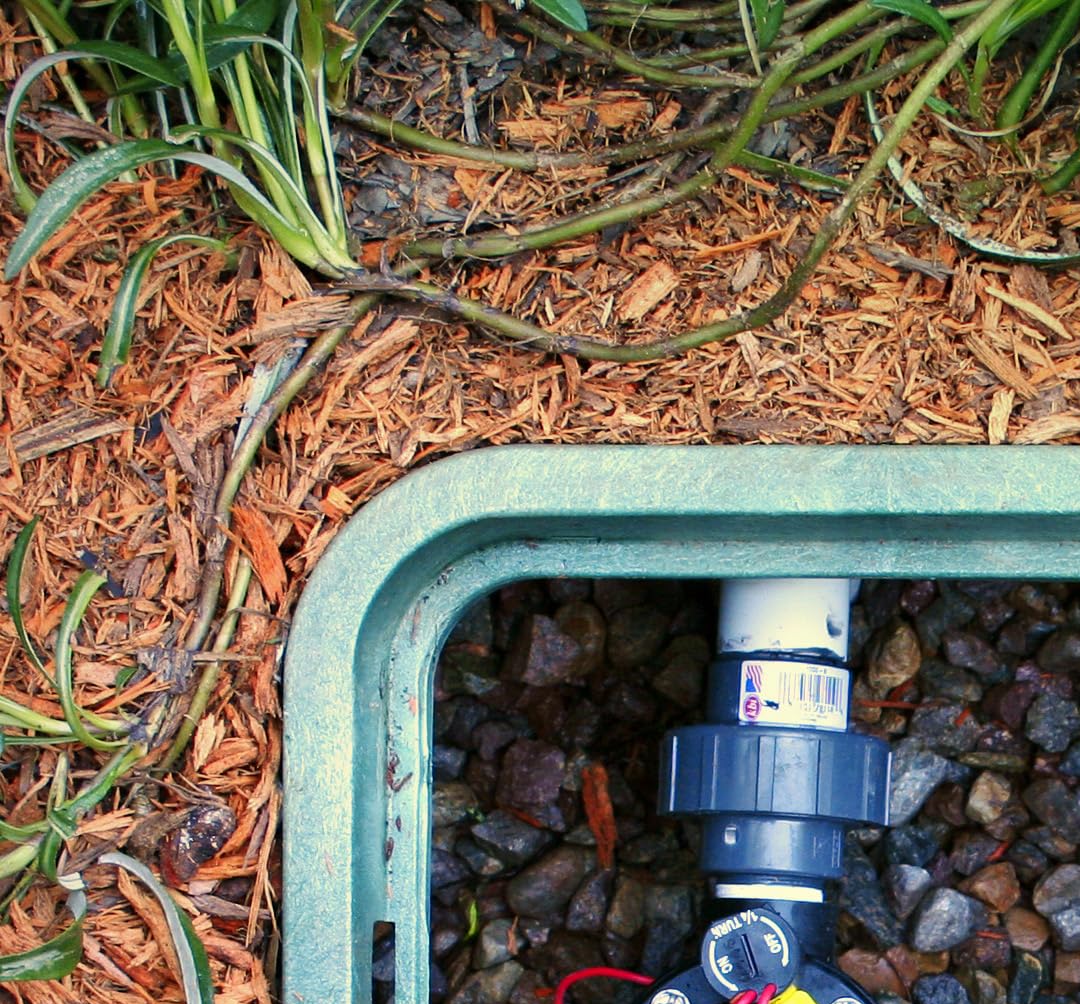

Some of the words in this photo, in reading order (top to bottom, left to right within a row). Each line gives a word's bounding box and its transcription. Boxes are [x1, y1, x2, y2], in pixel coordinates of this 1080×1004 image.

[710, 916, 743, 939] TURN
[763, 933, 782, 954] OFF
[716, 955, 733, 974] ON
